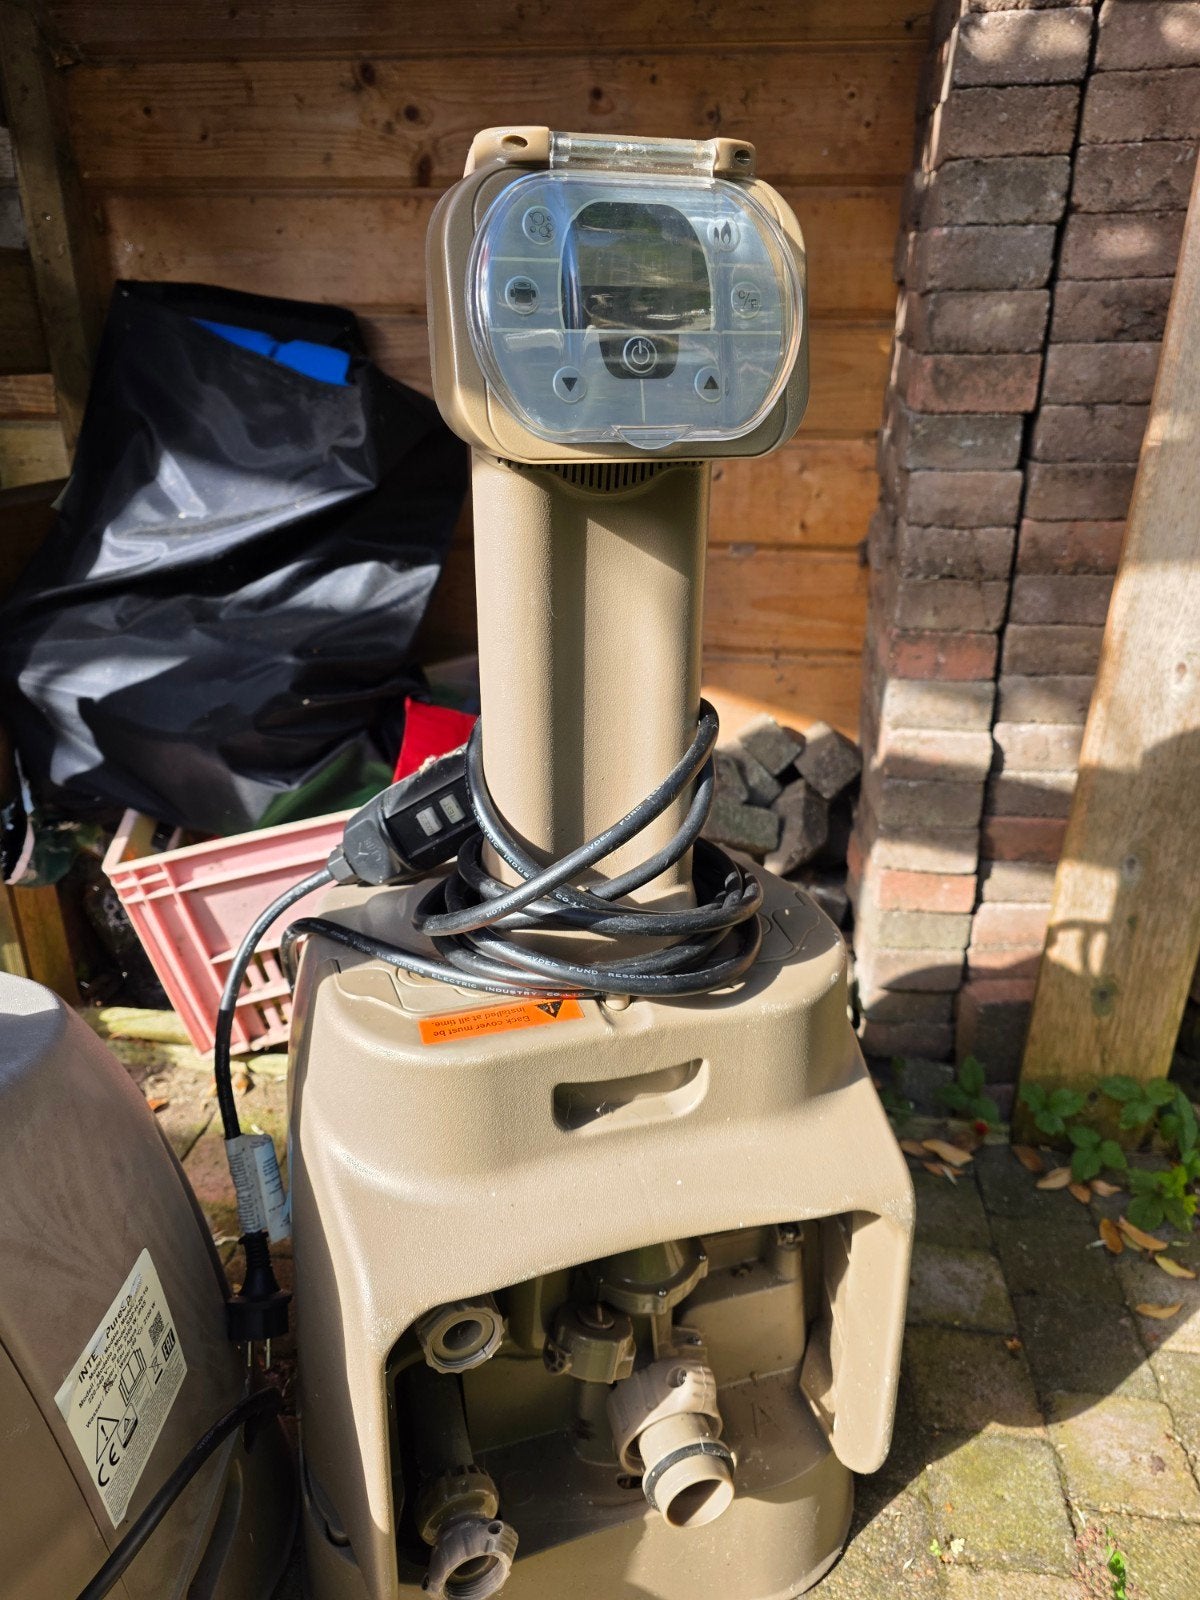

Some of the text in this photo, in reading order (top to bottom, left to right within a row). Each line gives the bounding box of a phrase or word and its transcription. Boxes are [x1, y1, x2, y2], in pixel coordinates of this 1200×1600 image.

[569, 965, 599, 975] FUND
[431, 973, 477, 988] ELECTRIC
[485, 986, 538, 996] INDUSTRY
[432, 1018, 456, 1027] time.
[433, 1015, 531, 1037] Back cover must be
[458, 1016, 470, 1025] all
[78, 1351, 98, 1383] INTE
[98, 1442, 120, 1487] CE
